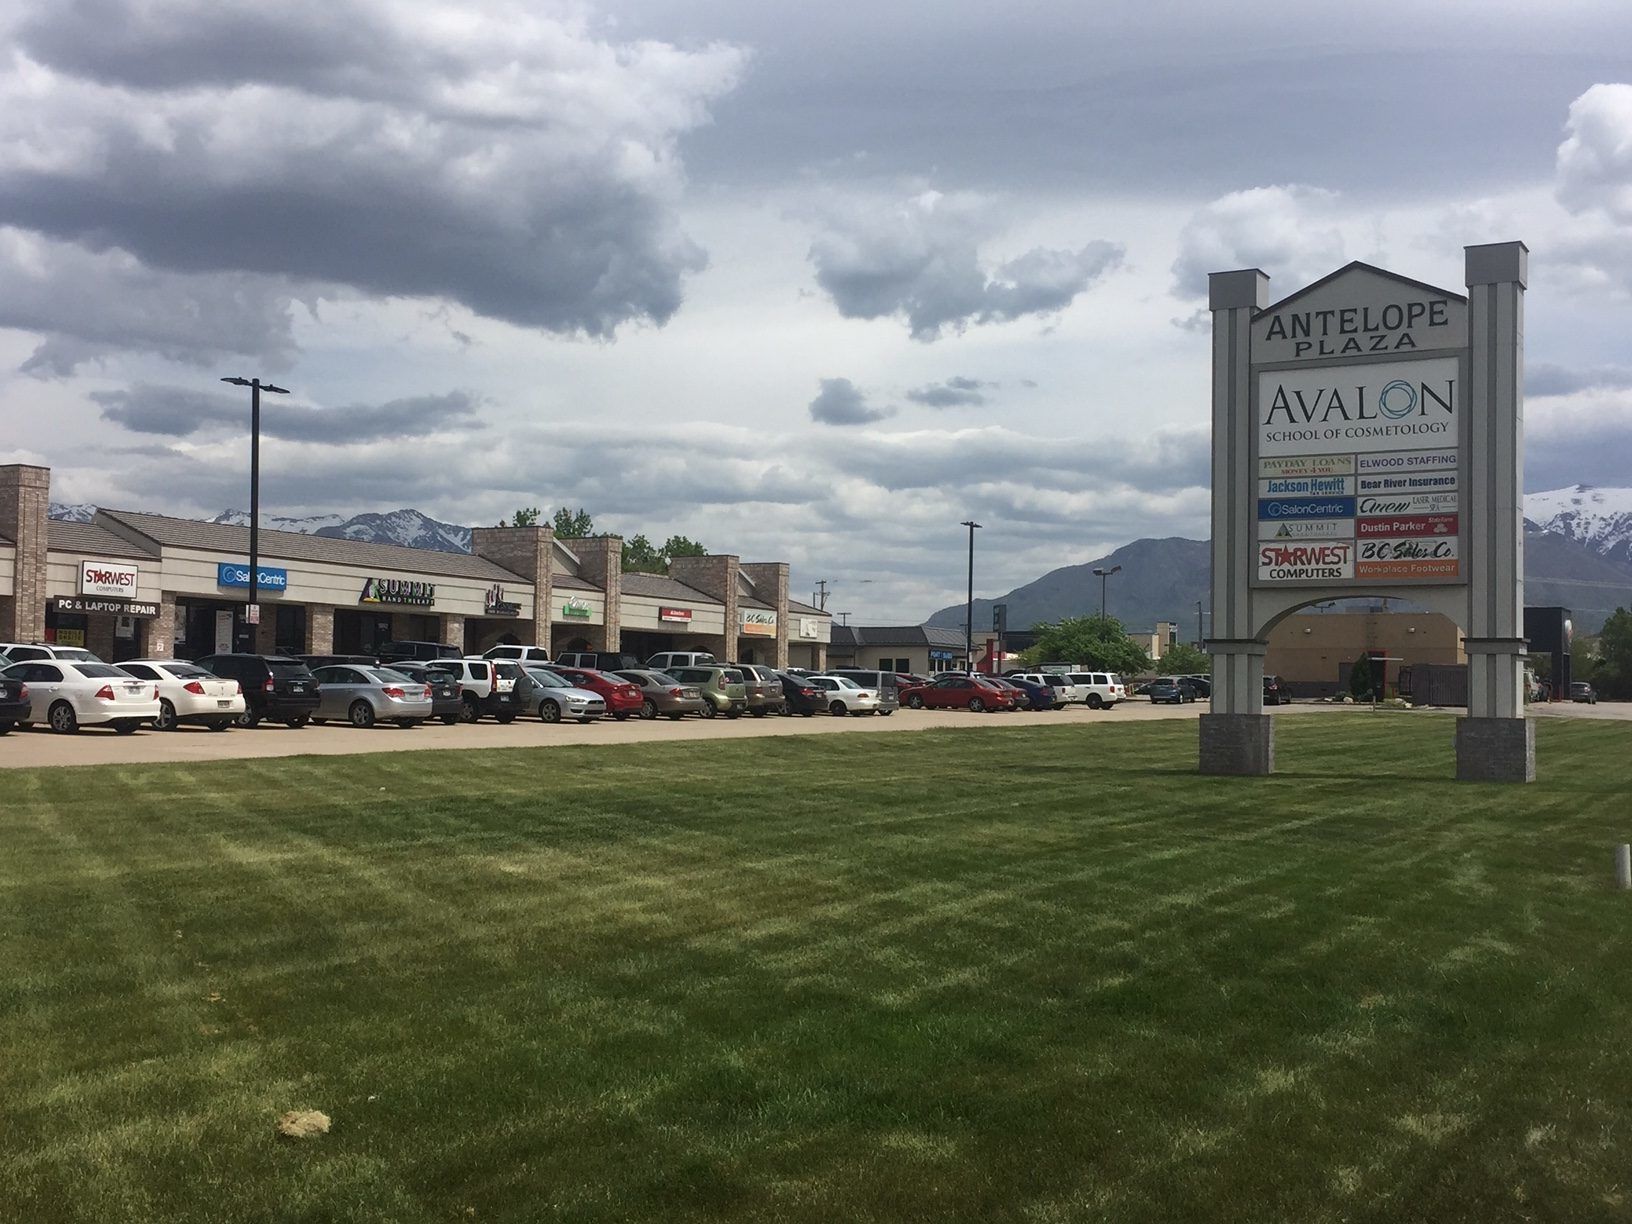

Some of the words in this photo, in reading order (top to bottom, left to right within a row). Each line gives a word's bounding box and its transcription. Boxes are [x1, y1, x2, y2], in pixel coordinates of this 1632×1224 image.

[1265, 299, 1448, 341] ANTELOPE
[1295, 332, 1417, 357] PLAZA
[1263, 379, 1456, 426] AVALON
[1266, 429, 1320, 443] SCHOOL
[1323, 428, 1341, 440] OF
[1345, 422, 1449, 439] COSMETOLOGY
[1263, 459, 1307, 469] PAYDAY
[1312, 456, 1352, 467] LOANS
[1360, 458, 1404, 468] ELWOOD
[1407, 455, 1457, 466] STAFFING
[1267, 480, 1310, 493] Jackson
[1310, 477, 1345, 491] Hewitt
[1360, 480, 1381, 489] Bear
[1383, 478, 1407, 488] River
[1409, 476, 1456, 487] Insurance
[1281, 504, 1344, 515] SalonCentric
[1289, 522, 1338, 532] SUMMIT
[1360, 523, 1390, 532] Dustin
[1392, 521, 1426, 531] Parker
[1361, 542, 1391, 559] BC
[1269, 567, 1342, 579] COMPUTERS
[1359, 564, 1408, 574] Workplace
[1410, 564, 1455, 573] Footwear
[58, 599, 72, 609] PC
[75, 600, 82, 609] &
[85, 601, 121, 612] LAPTOP
[123, 604, 156, 615] REPAIR
